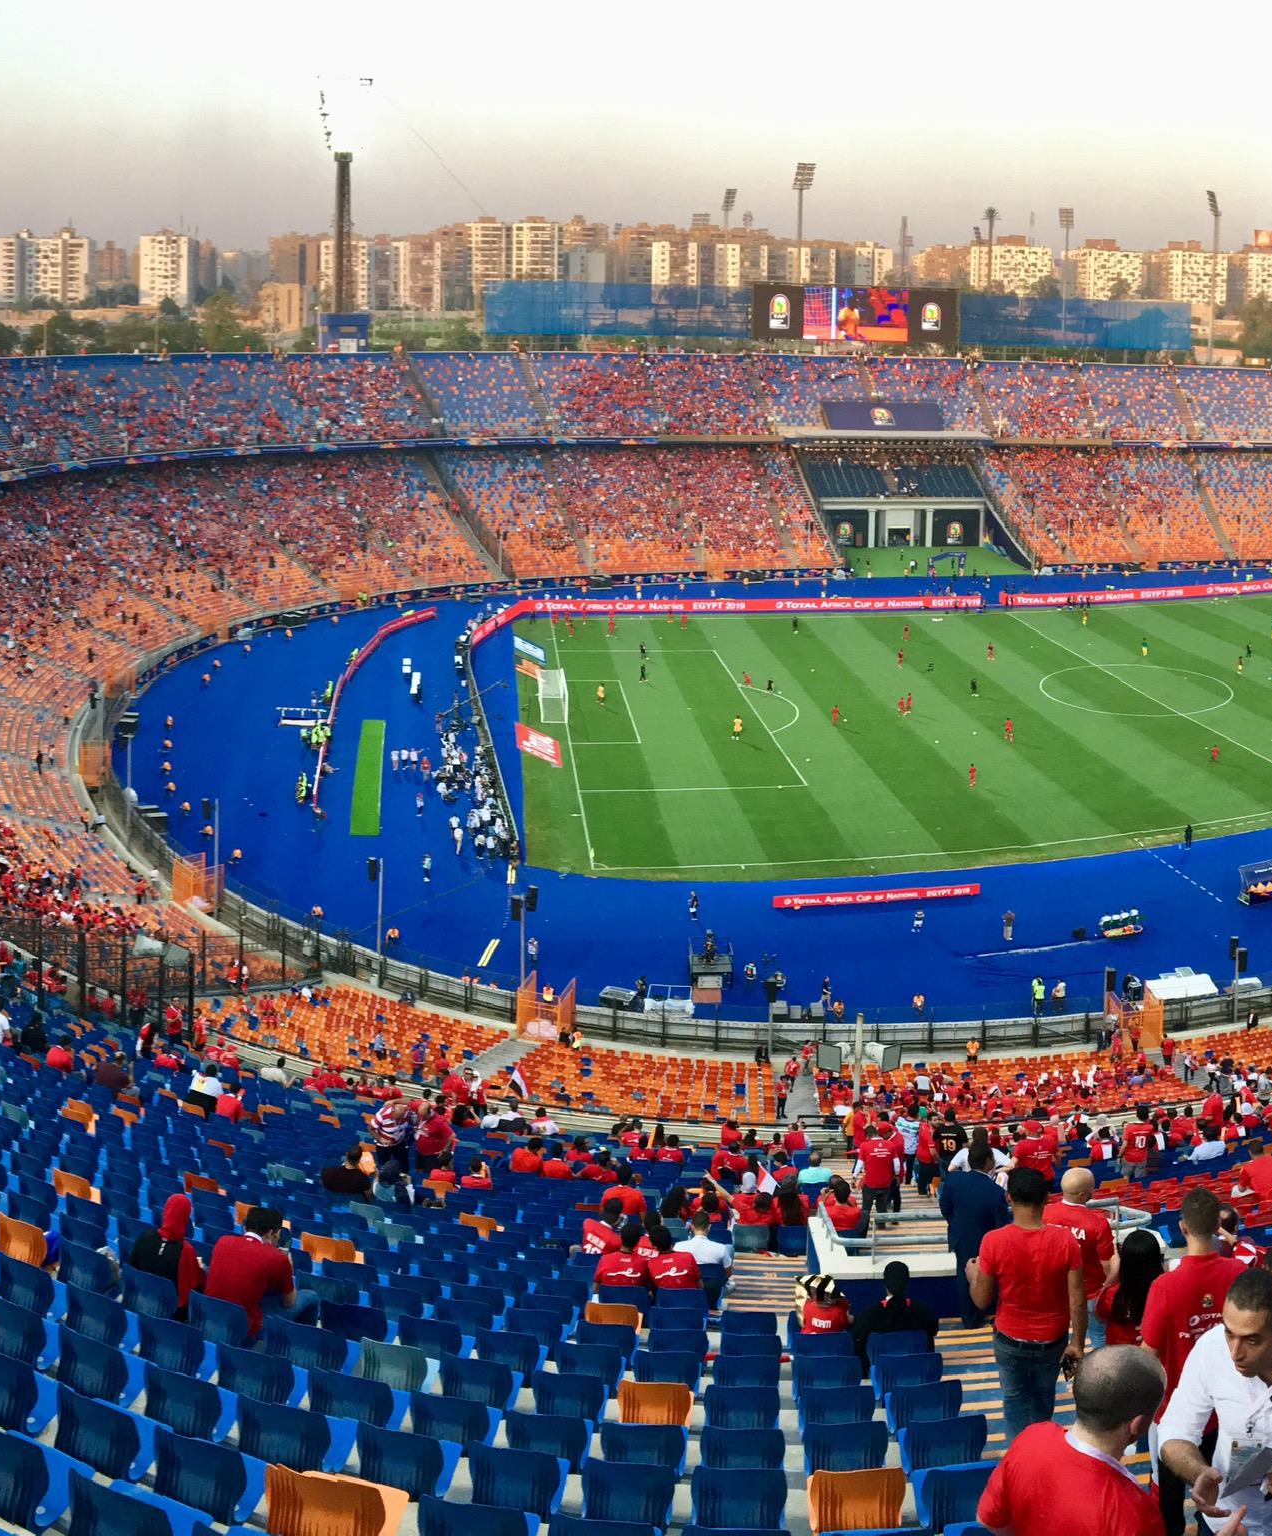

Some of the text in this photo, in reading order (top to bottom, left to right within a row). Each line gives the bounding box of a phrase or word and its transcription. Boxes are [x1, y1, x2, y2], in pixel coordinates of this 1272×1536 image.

[1016, 596, 1045, 604] TOTAL
[1140, 590, 1166, 598] EGYPT
[1167, 589, 1184, 597] 2019
[545, 602, 576, 610] TOTAL
[615, 602, 635, 610] CUP
[692, 602, 723, 610] EGYPT
[725, 602, 746, 610] 2019
[785, 601, 818, 609] TOTAL
[854, 600, 872, 608] CUP
[825, 894, 853, 903] AFRICA
[856, 894, 872, 902] CUP
[886, 891, 919, 900] NATIONS
[926, 888, 951, 897] EGYPT
[953, 887, 971, 895] 2019
[941, 1139, 956, 1152] 19
[1134, 1135, 1147, 1149] 10
[1200, 1312, 1223, 1321] TOTA
[811, 1317, 832, 1329] ADAM
